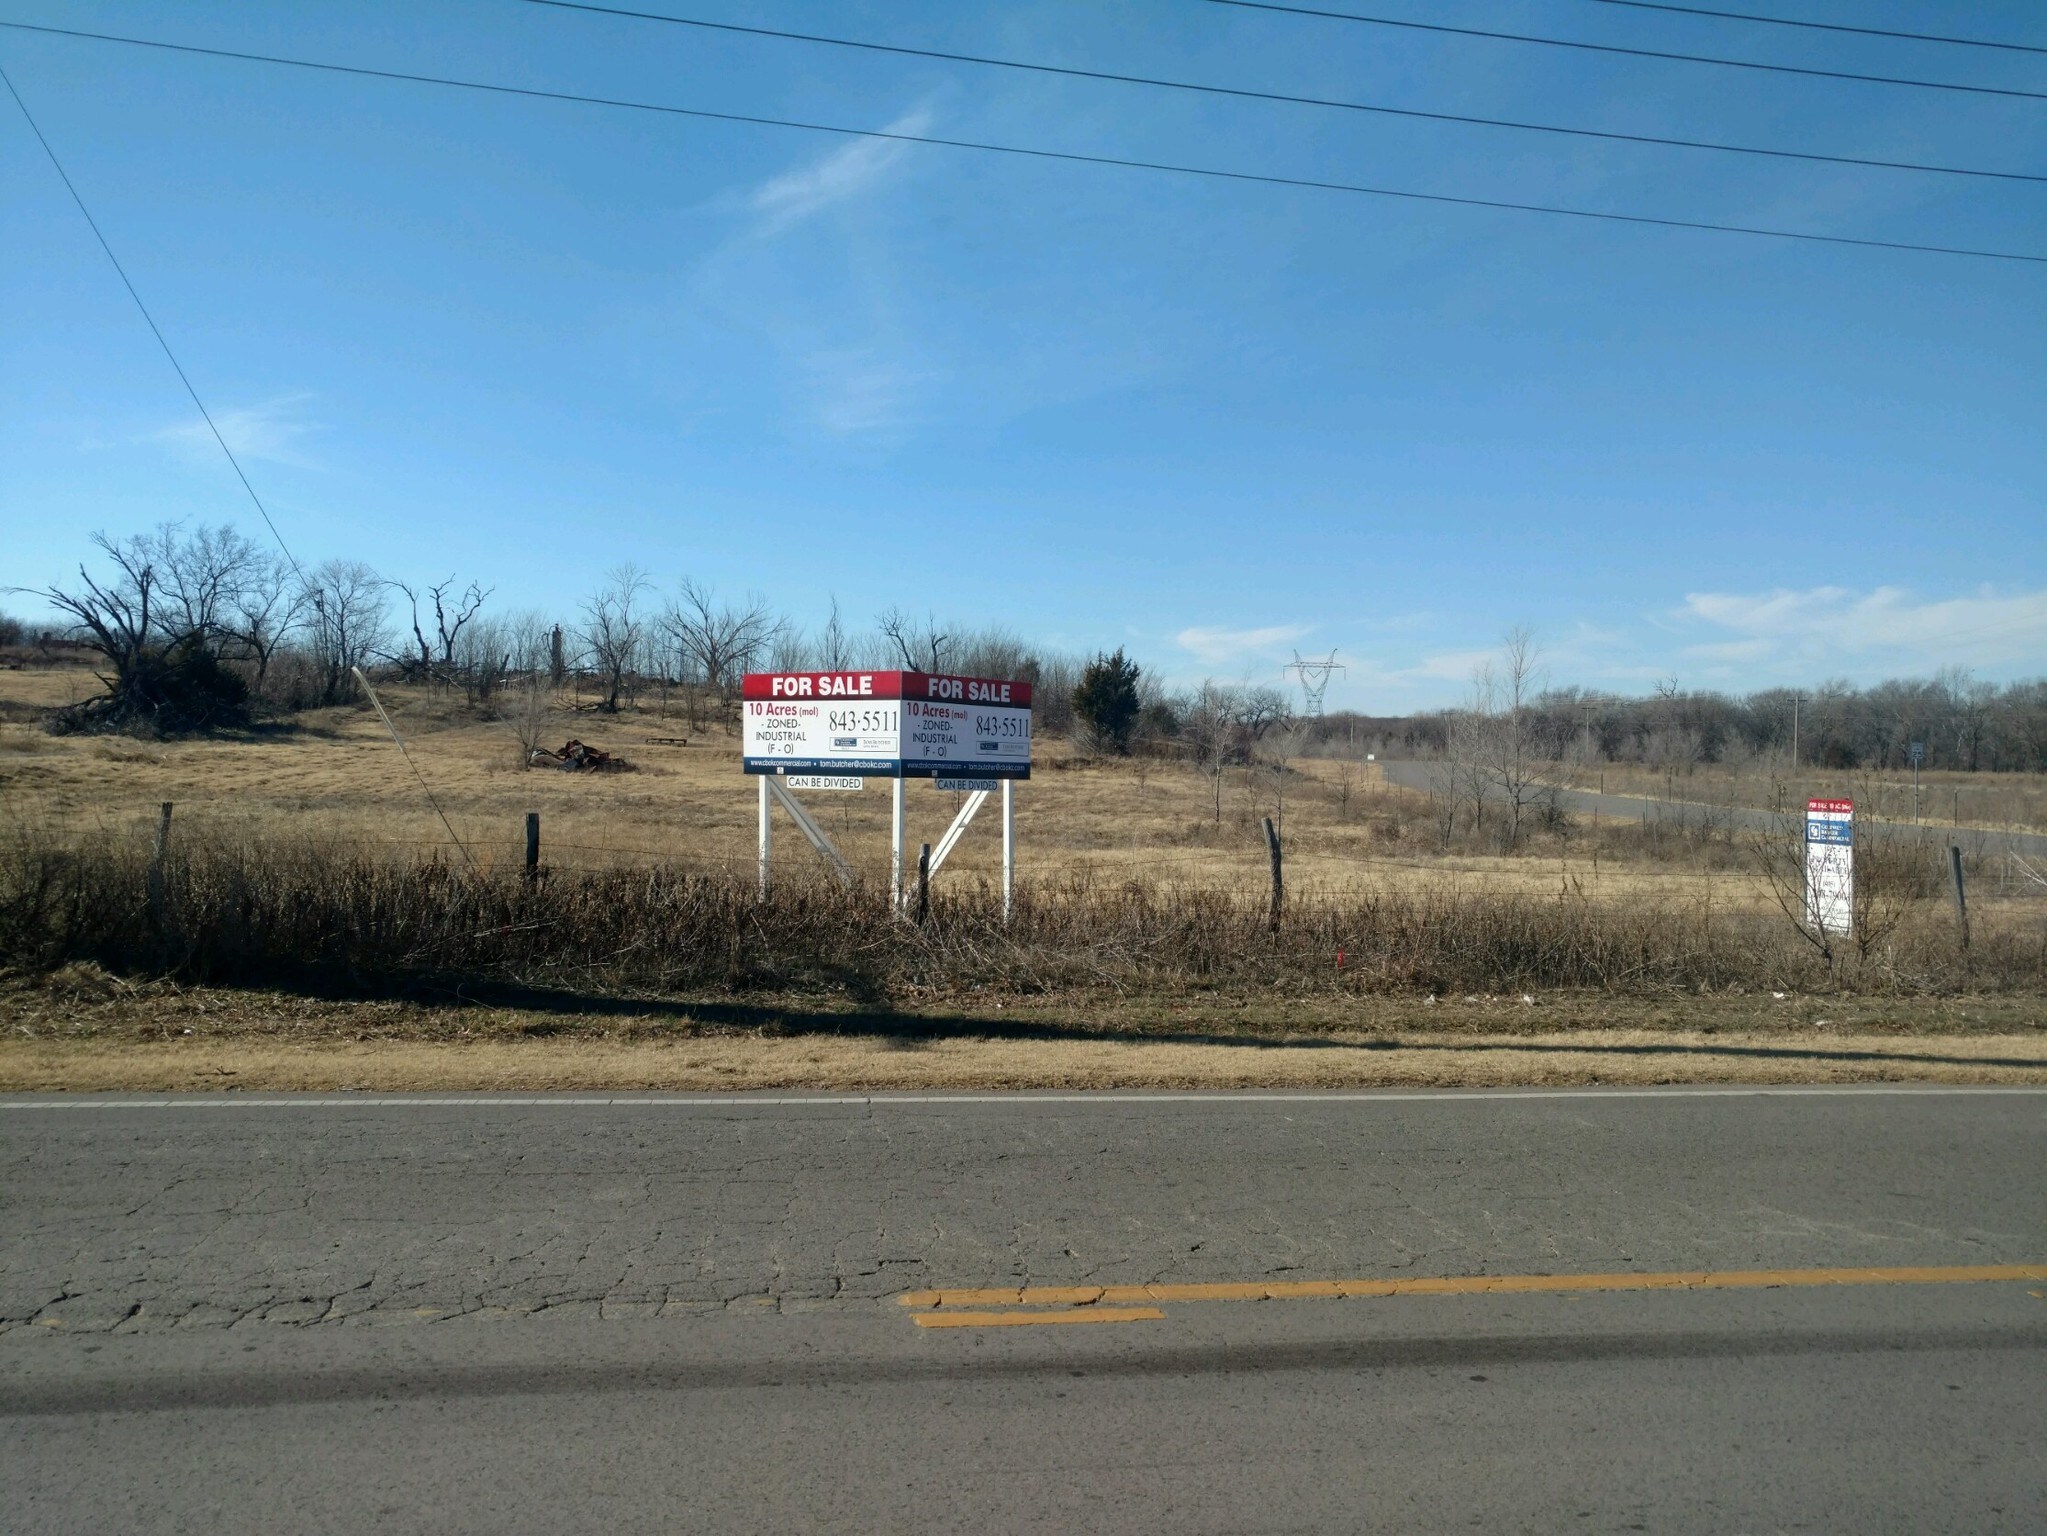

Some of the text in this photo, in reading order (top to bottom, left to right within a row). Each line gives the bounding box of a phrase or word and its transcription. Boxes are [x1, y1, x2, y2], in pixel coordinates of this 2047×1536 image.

[772, 675, 873, 696] FOR SALE
[928, 677, 1011, 703] FOR SALE
[750, 702, 819, 718] 10 Acres (mol)
[907, 702, 968, 721] 10 Acres (mol)
[756, 731, 807, 742] INDUSTRIAL
[912, 733, 958, 745] INDUSTRIAL
[820, 760, 892, 769] tom.butcher@cbokc.com
[788, 777, 861, 788] CAN BE DIVIDED
[937, 780, 998, 790] CAN BE DIVIDED
